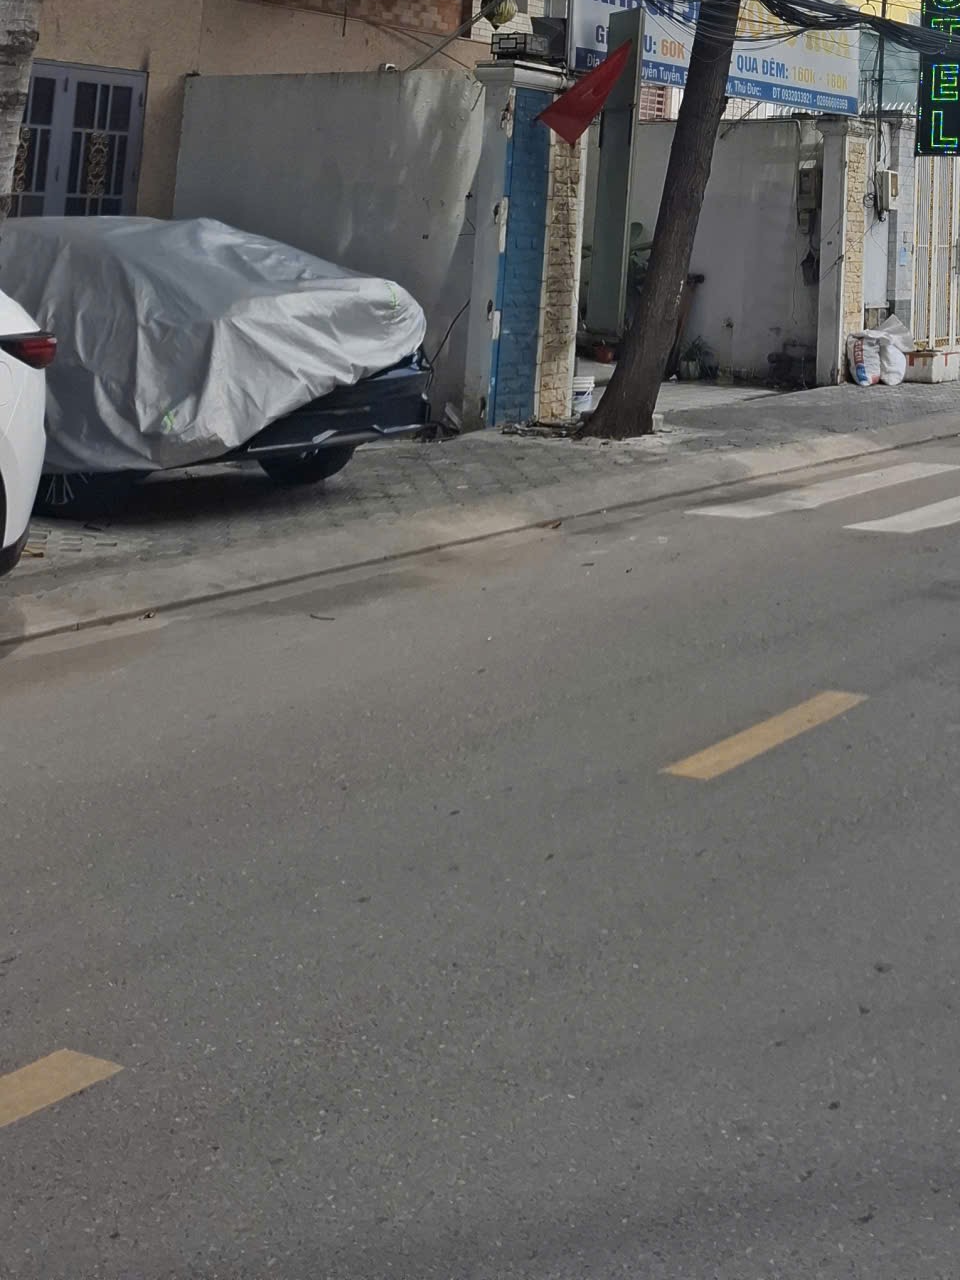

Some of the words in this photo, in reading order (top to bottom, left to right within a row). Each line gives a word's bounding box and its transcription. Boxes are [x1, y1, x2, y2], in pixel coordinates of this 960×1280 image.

[661, 38, 685, 60] 60K
[737, 54, 759, 74] QUA
[762, 58, 789, 79] ĐÊM:
